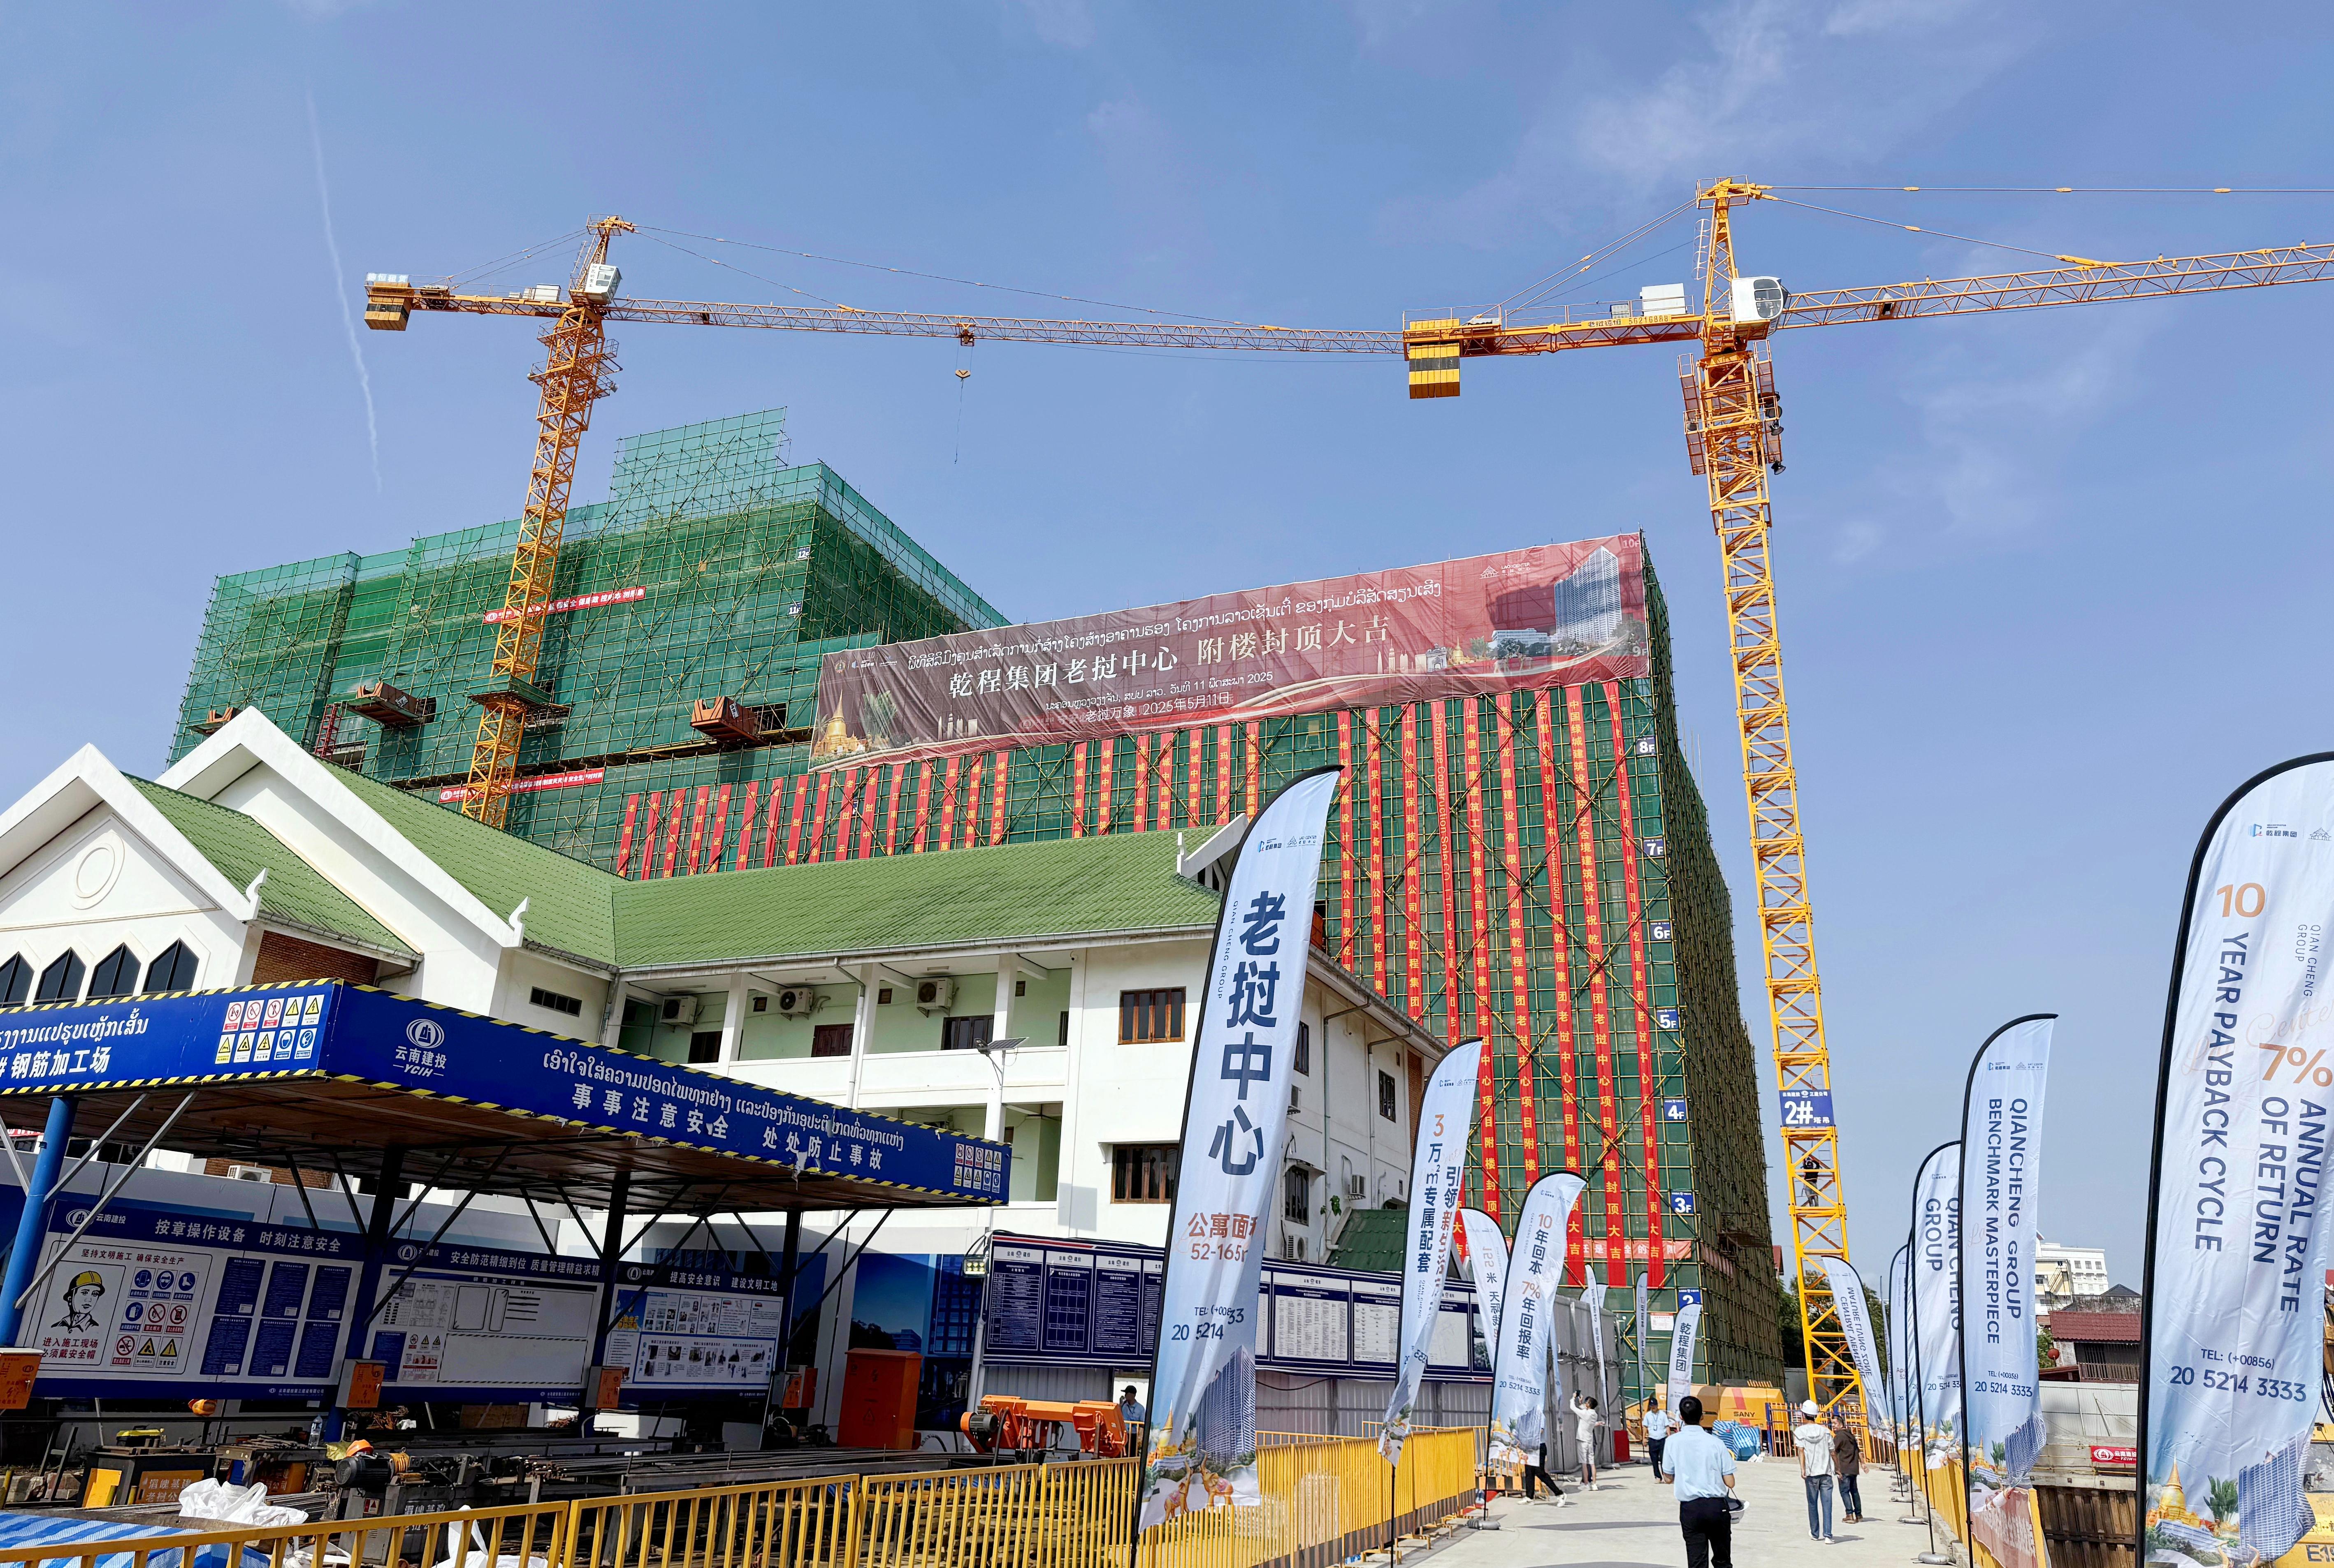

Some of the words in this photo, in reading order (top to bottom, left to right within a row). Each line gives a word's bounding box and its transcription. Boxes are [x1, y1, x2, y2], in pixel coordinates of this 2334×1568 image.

[949, 646, 1178, 699] 乾程集团老挝中心
[1198, 615, 1390, 666] 附楼封顶大吉
[1194, 681, 1205, 691] 11
[1247, 671, 1274, 683] 2025
[1086, 704, 1135, 724] 老挝万象
[1144, 691, 1230, 716] 2025年5月11日
[1640, 741, 1655, 754] 8F
[1647, 843, 1663, 856] 7F
[1228, 900, 1239, 925] QIAN
[2216, 882, 2266, 918] 10
[1223, 927, 1234, 961] CHENG
[1654, 926, 1670, 939] 6F
[2294, 924, 2308, 962] GROUP
[2308, 924, 2321, 952] QIAN
[1218, 965, 1227, 1000] GROUP
[2215, 931, 2249, 1003] YEAR
[2303, 956, 2319, 998] CHENG
[1208, 890, 1286, 1176] 老挝中心
[1659, 1014, 1677, 1029] 5F
[11, 1046, 112, 1079] 钢筋加工场
[395, 1046, 447, 1070] 云南建投
[404, 1064, 433, 1078] YCIH
[2259, 1043, 2334, 1088] 7%
[2202, 1011, 2237, 1149] PAYBACK
[572, 1083, 729, 1139] 事事注意安全
[762, 1126, 882, 1170] 处处防止事故
[1668, 1105, 1684, 1120] 4F
[1784, 1100, 1813, 1124] 2#
[2260, 1096, 2290, 1136] OF
[1986, 1098, 2002, 1212] BENCHMARK
[2008, 1098, 2028, 1227] QIANCHENG
[2289, 1098, 2327, 1225] ANNUAL
[96, 1214, 126, 1224] 云南建投
[1674, 1197, 1691, 1214] 3F
[2195, 1157, 2227, 1252] CYCLE
[2253, 1143, 2286, 1264] RETURN
[155, 1218, 246, 1243] 按章操作设备
[259, 1231, 341, 1253] 时刻注意安全
[1926, 1198, 1943, 1272] GROUP
[81, 1248, 132, 1261] 坚持文明施工
[136, 1253, 185, 1265] 确保安全生产
[450, 1251, 527, 1270] 安全防范精细到位
[529, 1259, 601, 1277] 质量管理精益求精
[2280, 1234, 2308, 1313] RATE
[670, 1271, 720, 1286] 提高安全意识
[731, 1276, 778, 1292] 建设文明工地
[1985, 1216, 2000, 1344] MASTERPIECE
[2005, 1240, 2022, 1320] GROUP
[42, 1336, 99, 1349] 进入施工现场
[1171, 1324, 1190, 1341] 20
[1675, 1322, 1691, 1372] 乾程集团
[2200, 1348, 2223, 1363] TEL:
[2227, 1352, 2276, 1371] (+00856)
[1928, 1382, 1937, 1390] 20
[1975, 1381, 1987, 1392] 20
[1990, 1382, 2008, 1394] 5214
[2011, 1384, 2033, 1397] 3333
[2169, 1366, 2195, 1385] 20
[2203, 1369, 2249, 1394] 5214
[2257, 1377, 2307, 1402] 3333
